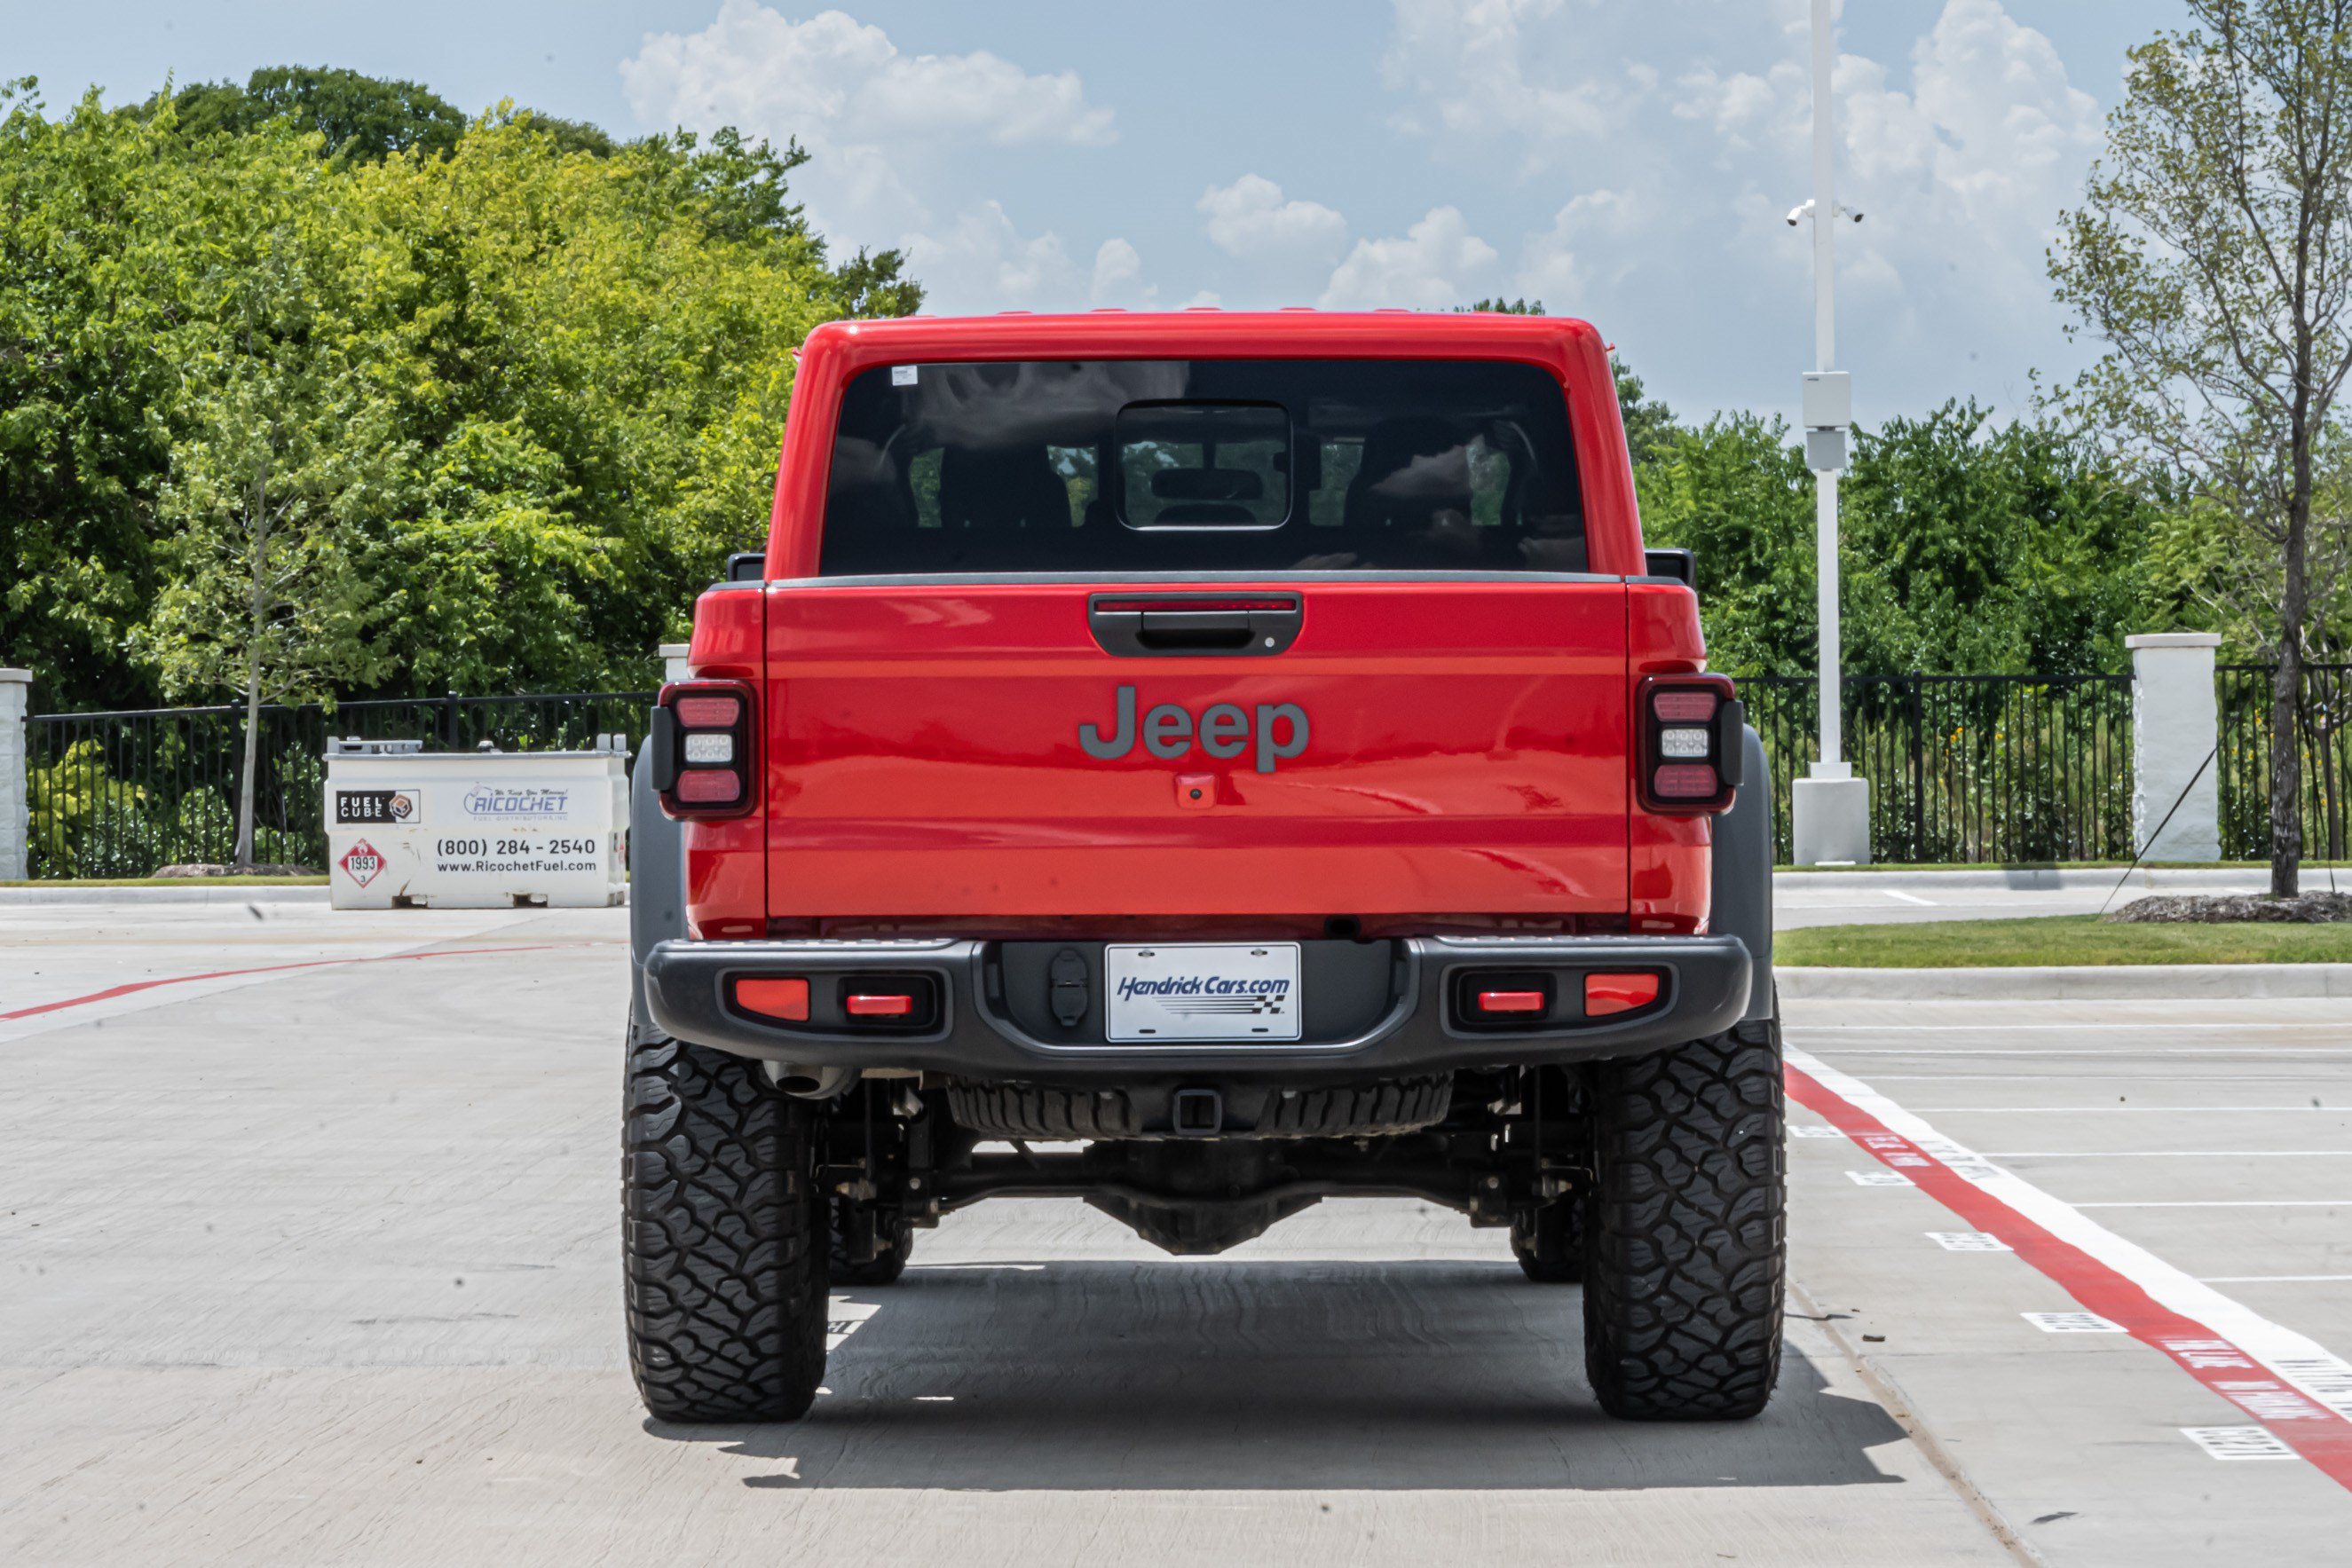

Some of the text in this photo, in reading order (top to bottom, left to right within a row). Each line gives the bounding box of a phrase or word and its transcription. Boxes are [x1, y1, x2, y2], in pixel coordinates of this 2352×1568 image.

[1078, 685, 1309, 773] Jeep
[341, 797, 382, 808] FUEL
[341, 808, 383, 817] CUBE
[437, 839, 487, 857] (800)
[496, 840, 531, 855] 284
[549, 839, 596, 854] 2540
[351, 856, 375, 870] 1993
[438, 860, 596, 872] www.RicochetFuel.com
